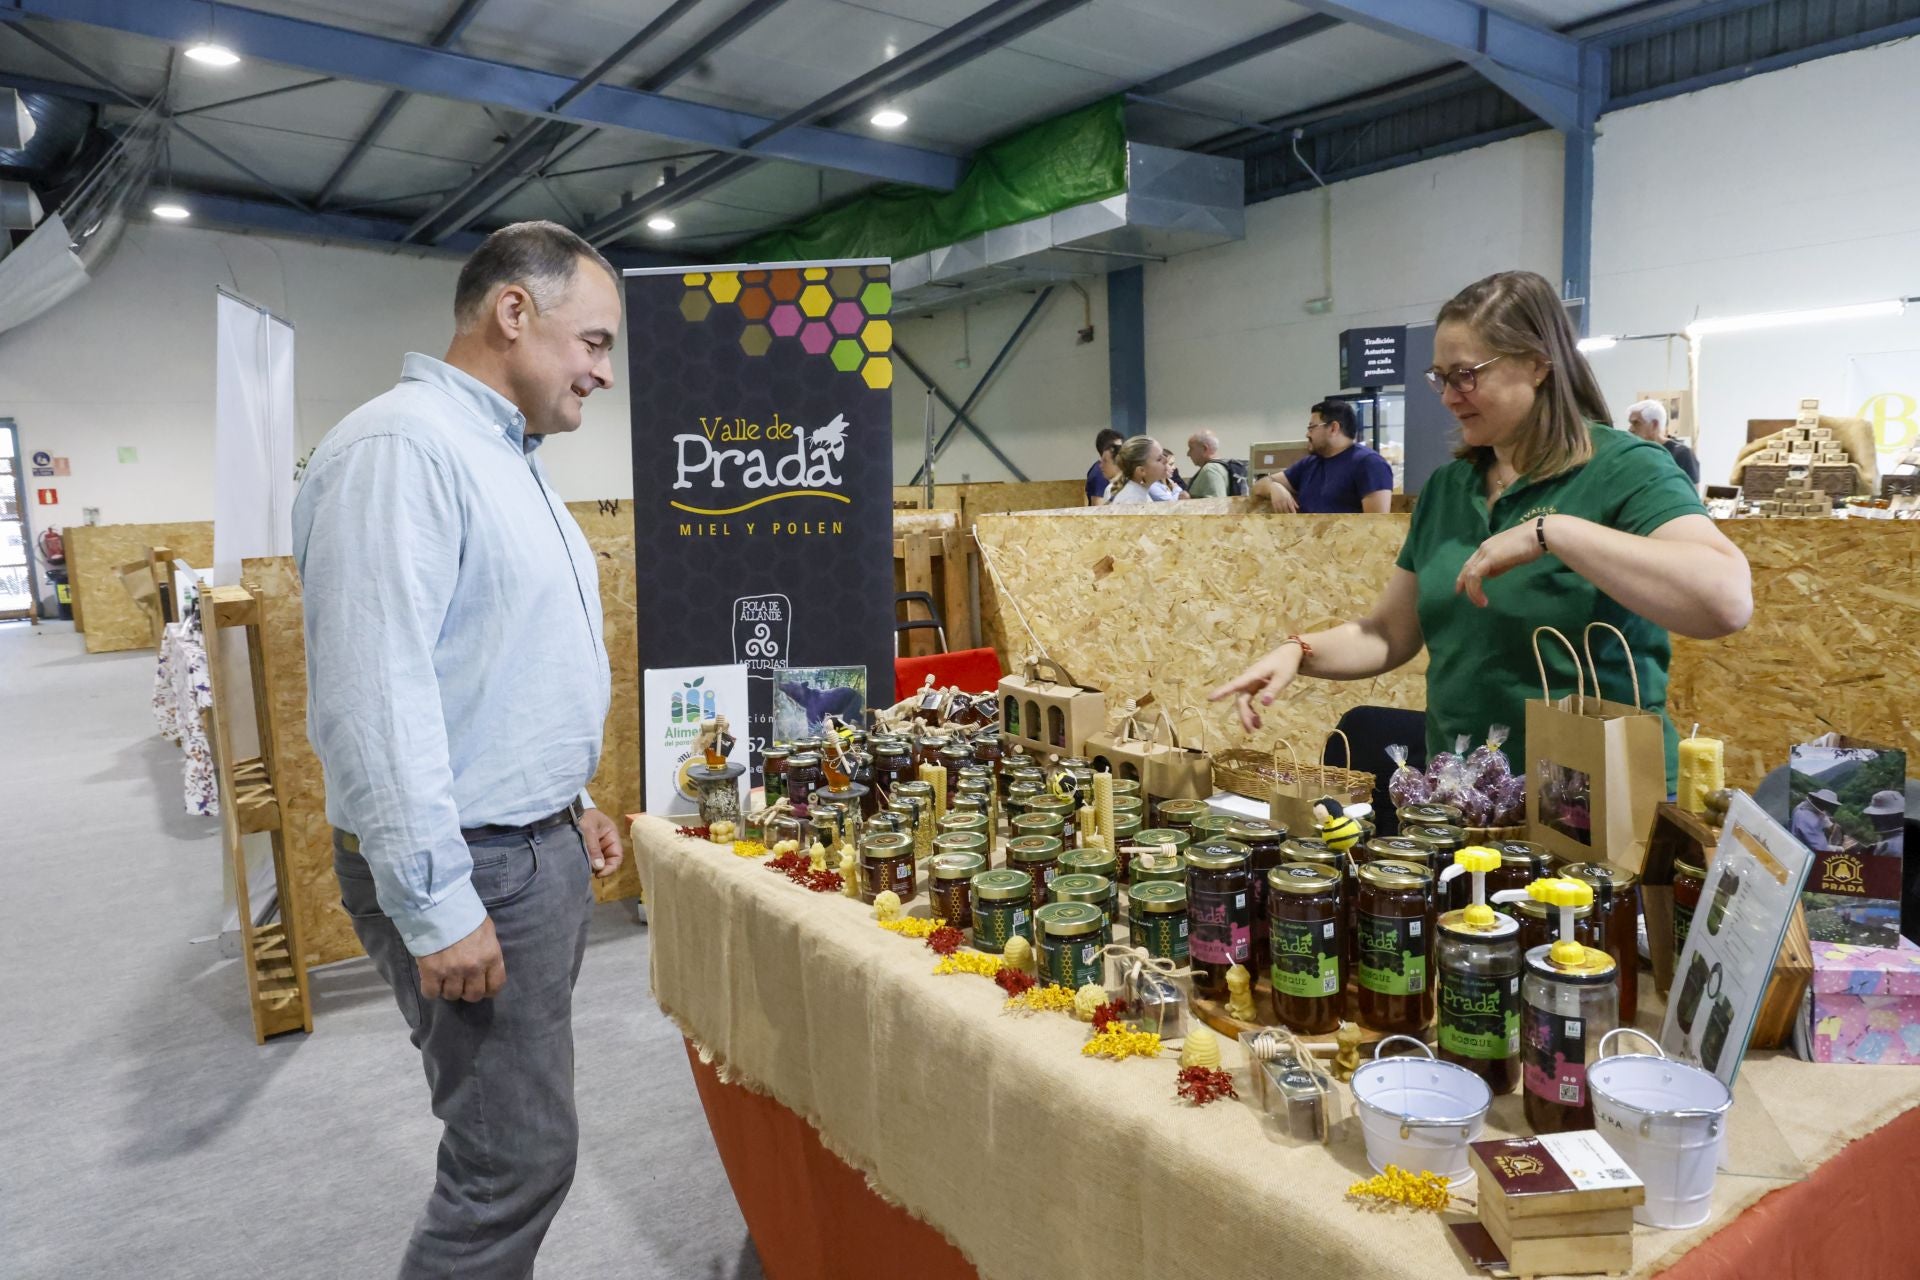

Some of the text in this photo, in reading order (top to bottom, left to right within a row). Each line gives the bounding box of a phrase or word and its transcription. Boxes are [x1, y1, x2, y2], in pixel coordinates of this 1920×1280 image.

[1364, 337, 1395, 345] Tradición
[1364, 348, 1395, 356] Asturiana
[1377, 357, 1392, 365] cada
[700, 413, 793, 441] Valle de
[672, 426, 842, 490] Prada
[680, 521, 843, 536] MIEL Y POLEN
[742, 601, 780, 612] POLA DE
[740, 611, 782, 621] ALLANDE
[664, 726, 700, 739] Alime
[1821, 882, 1866, 894] PRADA
[1443, 985, 1499, 1013] Prada
